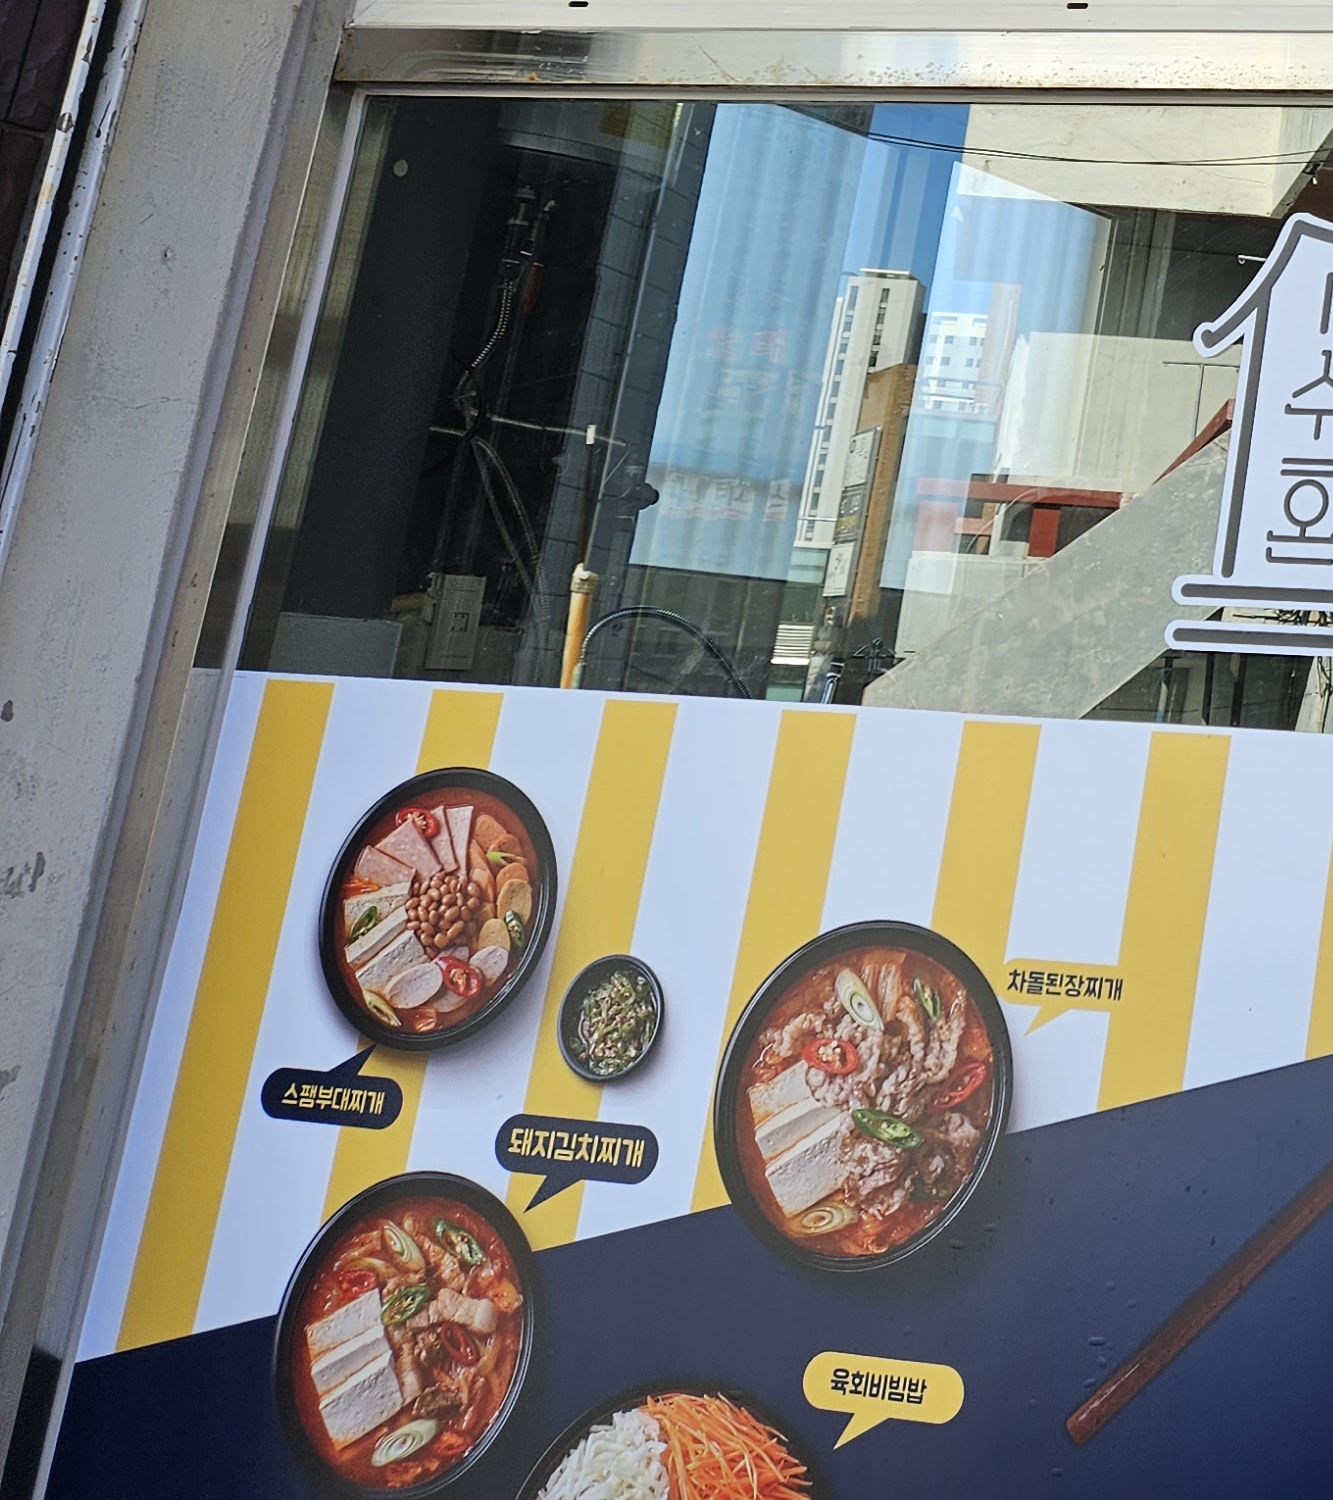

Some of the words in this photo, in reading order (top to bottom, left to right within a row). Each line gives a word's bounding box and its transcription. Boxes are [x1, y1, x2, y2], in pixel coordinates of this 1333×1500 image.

[1007, 968, 1124, 1001] 차돌된장찌개
[281, 1082, 386, 1115] 스팸부대찌개
[507, 1127, 646, 1169] 돼지김치찌개
[830, 1368, 928, 1405] 육회비빔밥
